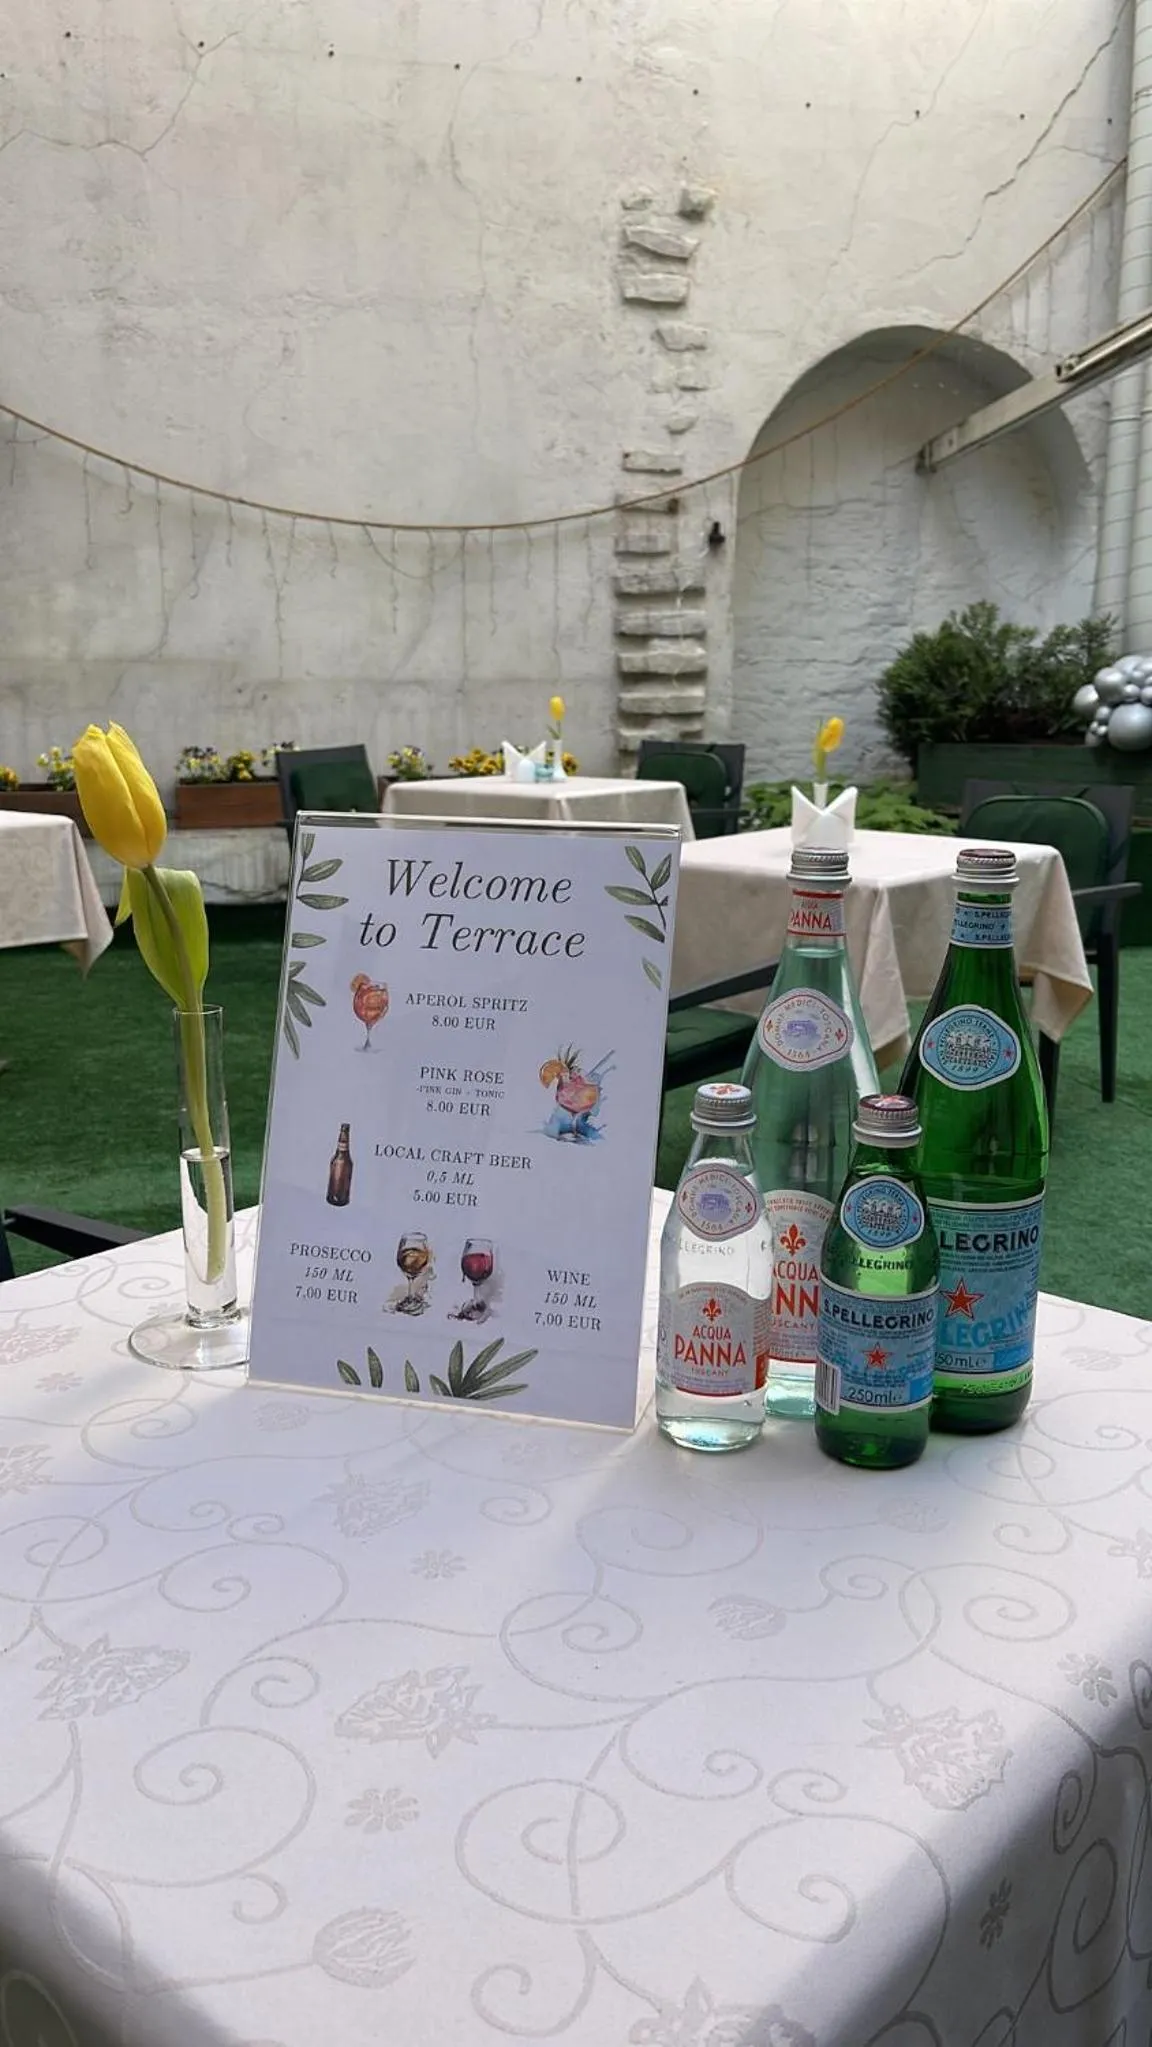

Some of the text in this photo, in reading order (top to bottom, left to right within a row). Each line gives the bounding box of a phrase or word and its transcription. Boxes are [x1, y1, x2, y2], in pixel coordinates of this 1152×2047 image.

[387, 859, 572, 904] Welcome
[360, 912, 586, 958] to Terrace
[405, 992, 529, 1012] APEROL SPRITZ
[431, 1014, 496, 1031] 8.00 EUR
[420, 1066, 505, 1085] PINK ROSE
[444, 1087, 462, 1096] GIN
[426, 1100, 491, 1116] 8.00 EUR
[374, 1144, 533, 1170] LOCAL CRAFT BEER
[451, 1172, 475, 1186] ML
[413, 1189, 479, 1207] 5.00 EUR
[939, 1225, 1039, 1253] LEGRINO
[290, 1242, 372, 1263] PROSECCO
[305, 1266, 354, 1282] 150 ML
[547, 1269, 591, 1286] WINE
[327, 1288, 358, 1303] EUR
[544, 1292, 597, 1308] 150 ML
[568, 1315, 601, 1330] EUR
[823, 1298, 935, 1330] S.PELLEGRINO
[692, 1324, 731, 1340] ACQUA
[674, 1333, 746, 1367] PANNA
